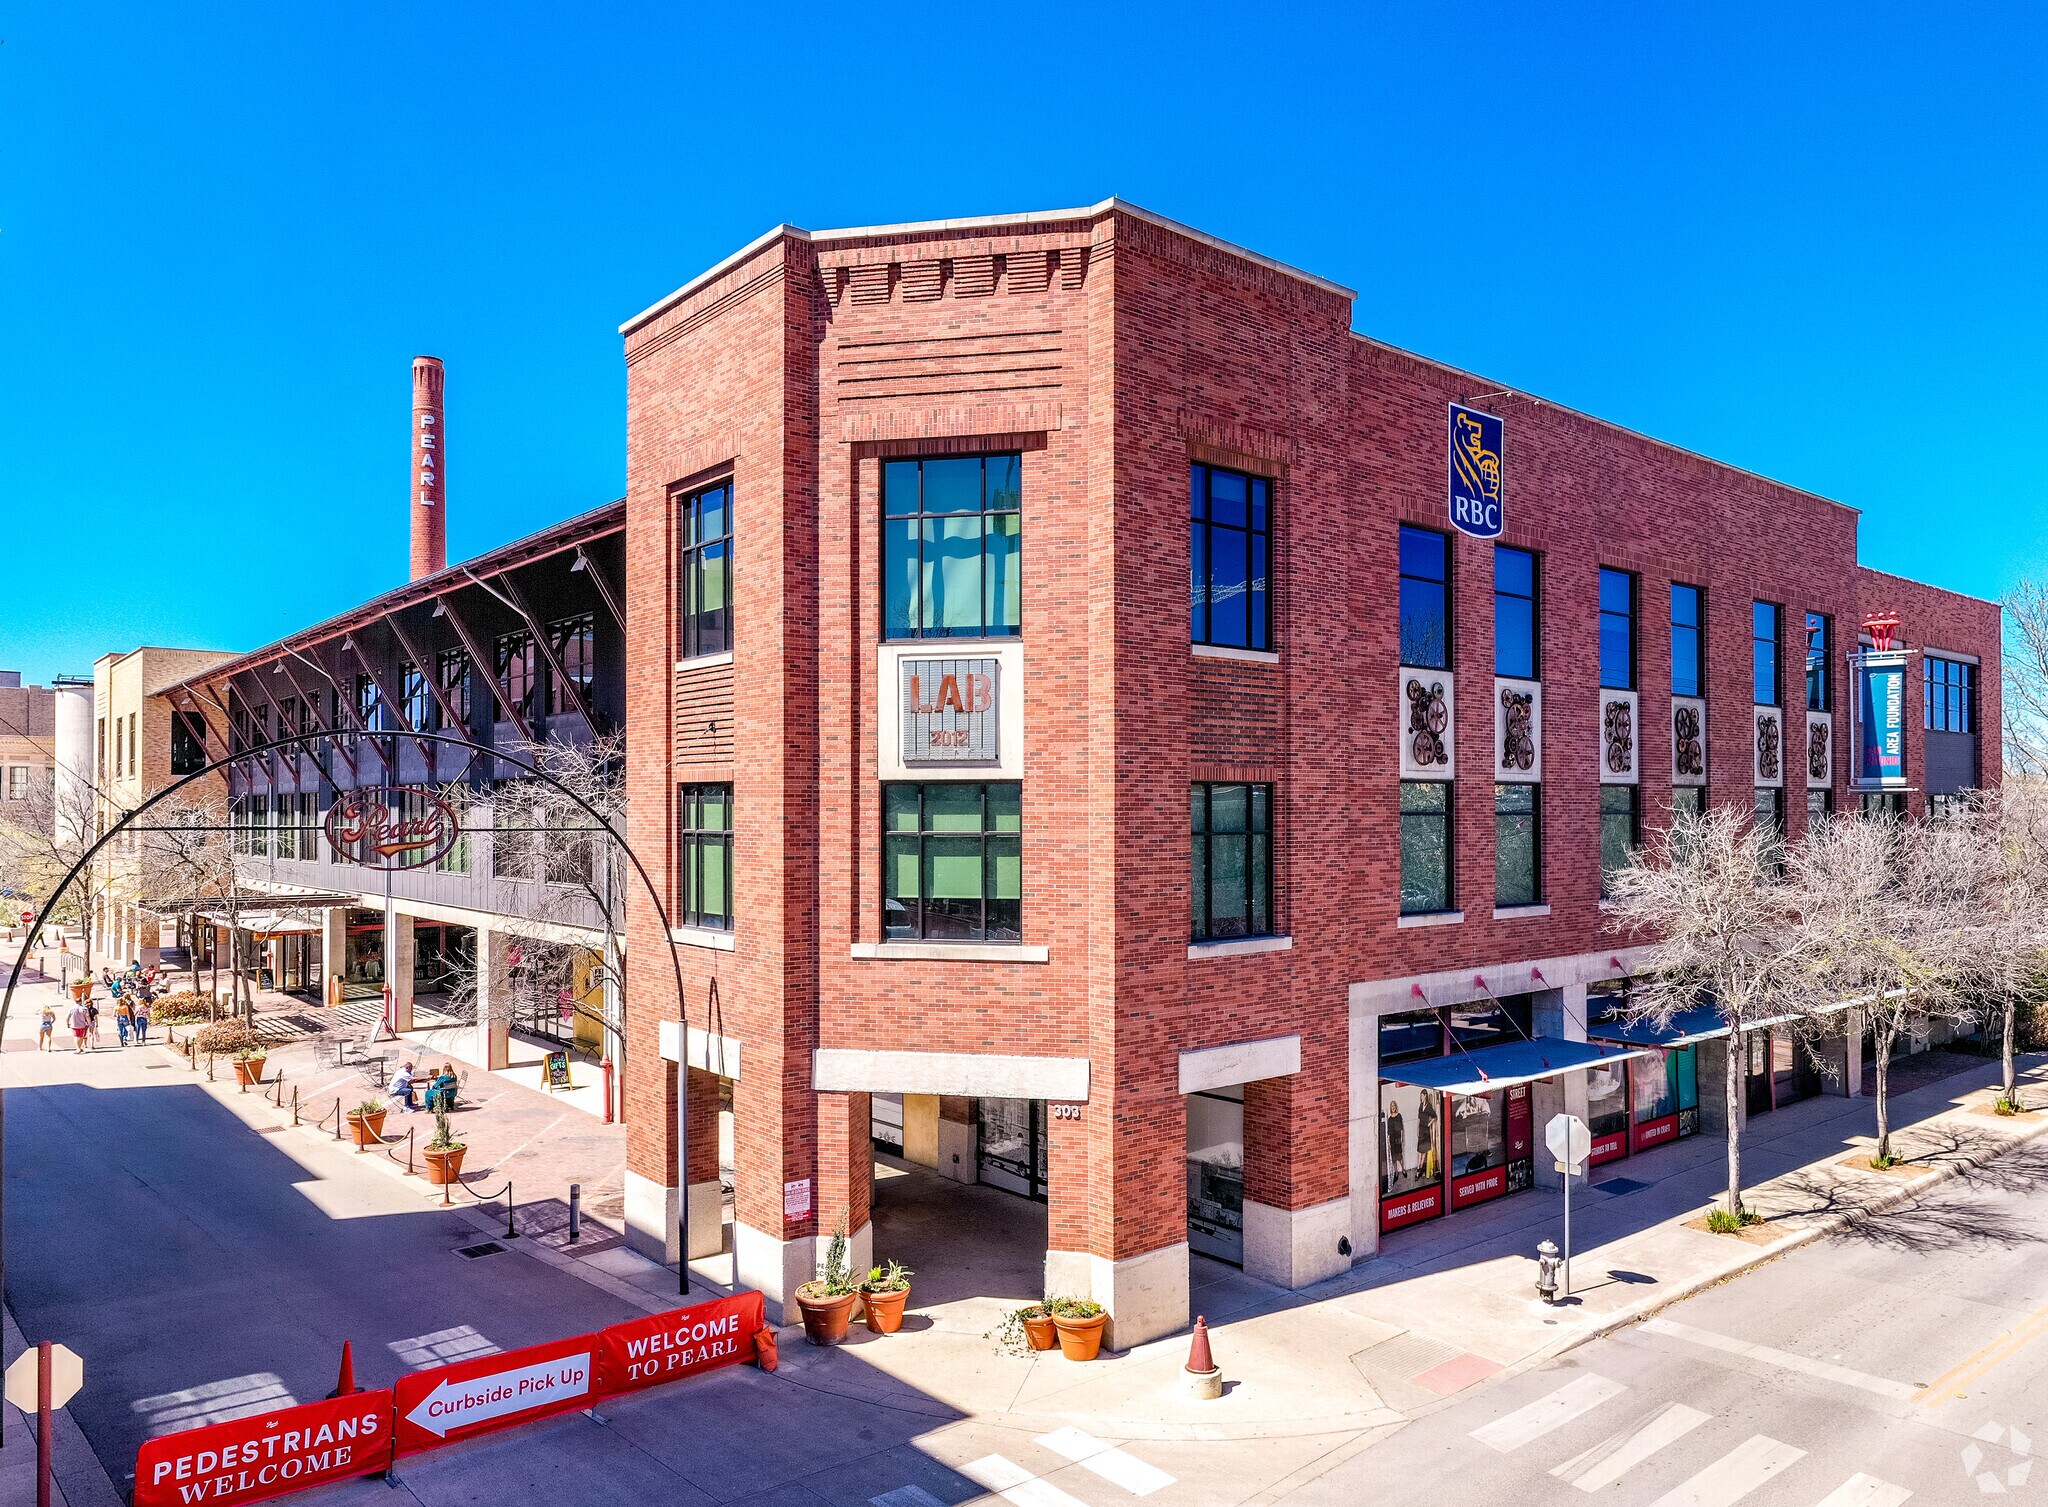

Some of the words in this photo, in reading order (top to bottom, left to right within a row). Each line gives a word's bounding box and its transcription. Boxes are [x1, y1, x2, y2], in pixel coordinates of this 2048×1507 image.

[420, 414, 435, 505] PEARL
[1455, 495, 1497, 529] RBC
[910, 674, 992, 713] LAB
[1886, 673, 1901, 728] FOUNDATION
[930, 730, 968, 747] 2012
[1886, 731, 1900, 755] AREA
[1867, 756, 1900, 766] ANTONIO
[341, 800, 445, 859] Pearl
[1054, 1104, 1081, 1118] 303
[1509, 1086, 1526, 1100] STREET
[1459, 1185, 1475, 1197] SERVED
[1475, 1180, 1486, 1192] WITH
[1486, 1177, 1498, 1189] PRIDE
[1387, 1205, 1407, 1220] MAKERS
[1407, 1204, 1412, 1214] &
[1412, 1196, 1435, 1213] BELIEVERS
[627, 1314, 739, 1359] WELCOME
[627, 1359, 659, 1381] TO
[666, 1338, 738, 1371] PEARL
[428, 1386, 513, 1418] Curbside
[518, 1374, 555, 1396] Pick
[560, 1368, 584, 1385] Up
[153, 1413, 379, 1486] PEDESTRIANS
[178, 1445, 352, 1505] WELCOME
